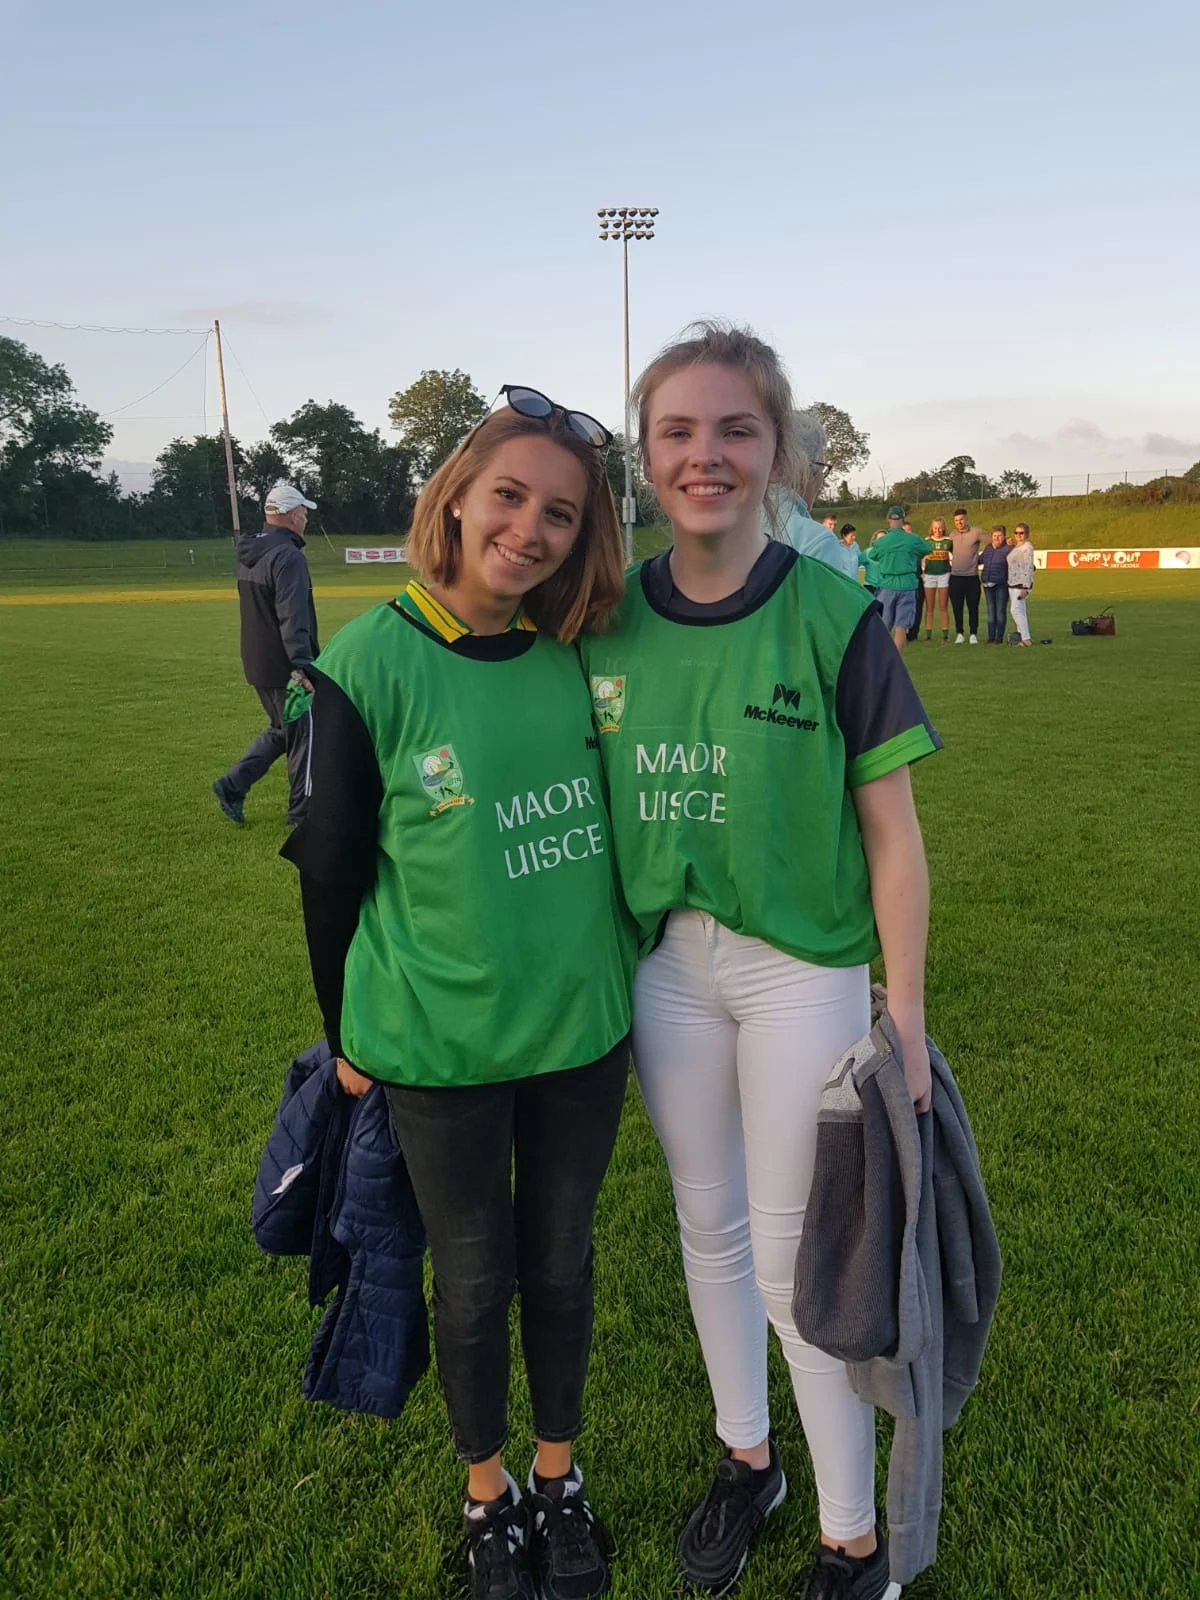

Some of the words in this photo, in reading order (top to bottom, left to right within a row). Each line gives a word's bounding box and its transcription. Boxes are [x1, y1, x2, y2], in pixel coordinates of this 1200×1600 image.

[744, 704, 820, 732] McKeever
[636, 742, 727, 776] MAOR
[494, 776, 596, 833] MAOR
[639, 790, 727, 823] UISCE
[504, 822, 604, 880] UISCE
